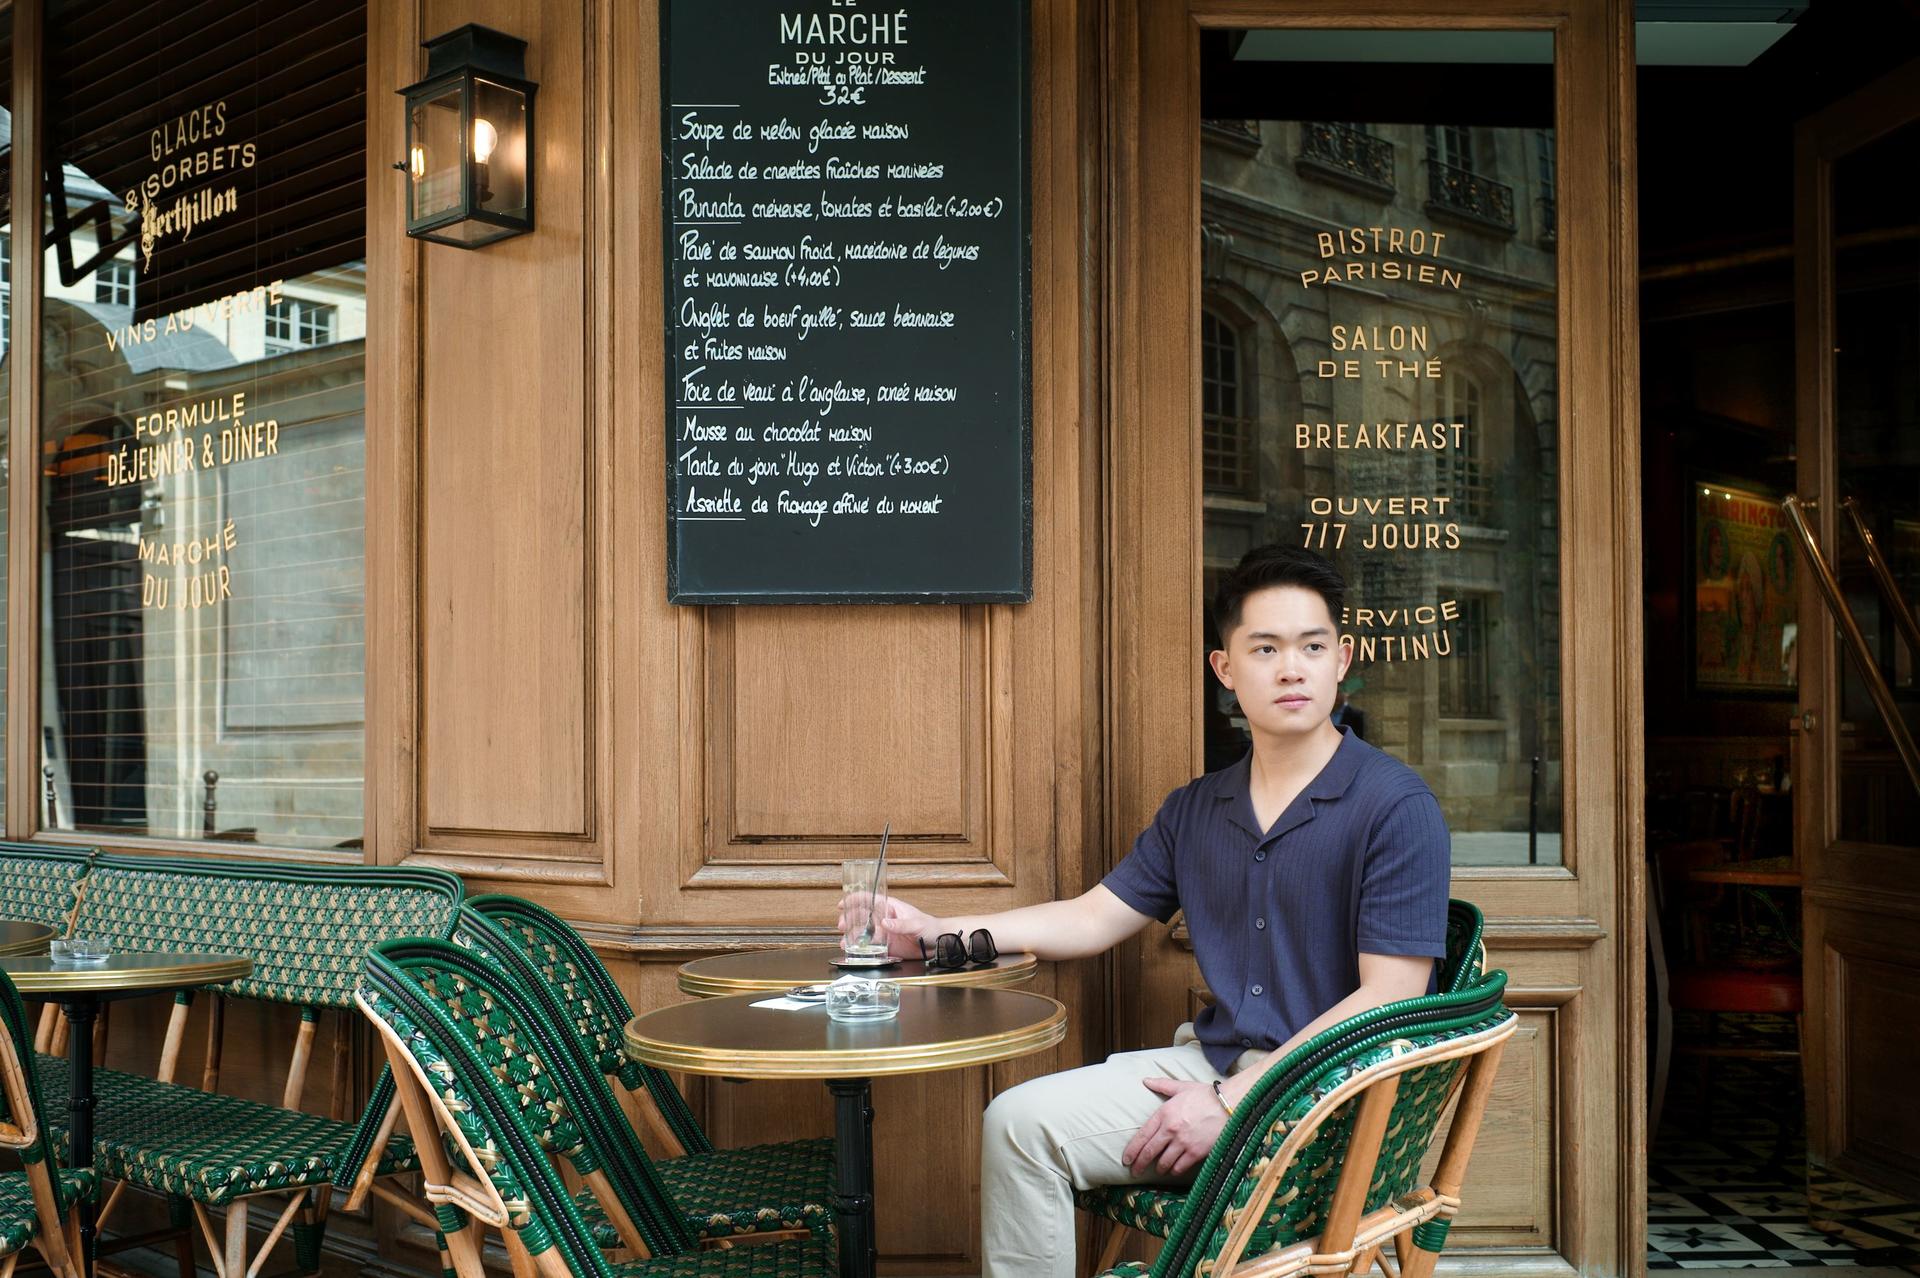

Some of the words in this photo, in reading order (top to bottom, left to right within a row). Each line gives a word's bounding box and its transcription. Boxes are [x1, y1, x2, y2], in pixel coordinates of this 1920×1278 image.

[780, 9, 908, 44] MARCHÉ
[795, 52, 826, 65] DU
[835, 52, 896, 65] JOUR
[835, 73, 846, 85] ou
[819, 85, 866, 105] 32€
[151, 101, 227, 162] GLACES
[679, 111, 725, 151] Soupe
[732, 120, 753, 140] de
[760, 117, 801, 140] melon
[808, 118, 857, 154] glacée
[862, 122, 909, 140] maison
[124, 189, 139, 214] &
[147, 143, 257, 198] SORBETS
[681, 152, 734, 180] Salade
[738, 161, 758, 180] de
[763, 160, 821, 180] crevettes
[678, 188, 746, 218] Burrata
[820, 189, 872, 218] tomates
[878, 196, 892, 218] et
[897, 195, 943, 218] basilic
[679, 229, 715, 261] Pavé
[719, 241, 737, 261] de
[743, 244, 796, 261] saumon
[845, 240, 908, 260] macédoine
[912, 240, 930, 260] de
[933, 234, 980, 270] légumes
[1317, 227, 1446, 259] BISTROT
[683, 267, 699, 287] et
[706, 270, 779, 288] mayonnaise
[1300, 261, 1462, 289] PARISIEN
[106, 318, 157, 351] VINS
[164, 306, 195, 336] AU
[737, 307, 755, 328] de
[850, 310, 886, 327] sauce
[893, 302, 955, 327] béarnaise
[684, 339, 699, 360] et
[747, 344, 787, 360] maison
[1331, 325, 1427, 352] SALON
[1318, 360, 1360, 378] DE
[1375, 356, 1442, 378] THÉ
[682, 365, 713, 402] Foie
[717, 379, 737, 402] de
[743, 382, 776, 402] veau
[781, 380, 794, 402] à
[914, 385, 957, 402] maison
[135, 392, 246, 441] FORMULE
[683, 415, 728, 442] Mousse
[735, 425, 756, 442] au
[763, 419, 822, 442] chocolat
[828, 425, 872, 442] maison
[1295, 423, 1465, 450] BREAKFAST
[107, 437, 195, 487] DÉJEUNER
[202, 433, 215, 469] &
[221, 420, 279, 465] DÎNER
[679, 446, 722, 477] Tarte
[727, 456, 744, 476] du
[747, 457, 780, 485] jour
[827, 456, 842, 476] et
[685, 486, 743, 513] Assiette
[751, 495, 769, 513] de
[832, 492, 870, 514] affiné
[876, 495, 894, 514] du
[899, 494, 942, 514] moment
[1310, 497, 1450, 516] OUVERT
[138, 518, 238, 566] MARCHÉ
[1300, 523, 1347, 549] 7/7
[1363, 523, 1461, 550] JOURS
[143, 573, 169, 610] DU
[175, 565, 232, 611] JOUR
[1341, 600, 1460, 627] ERVICE
